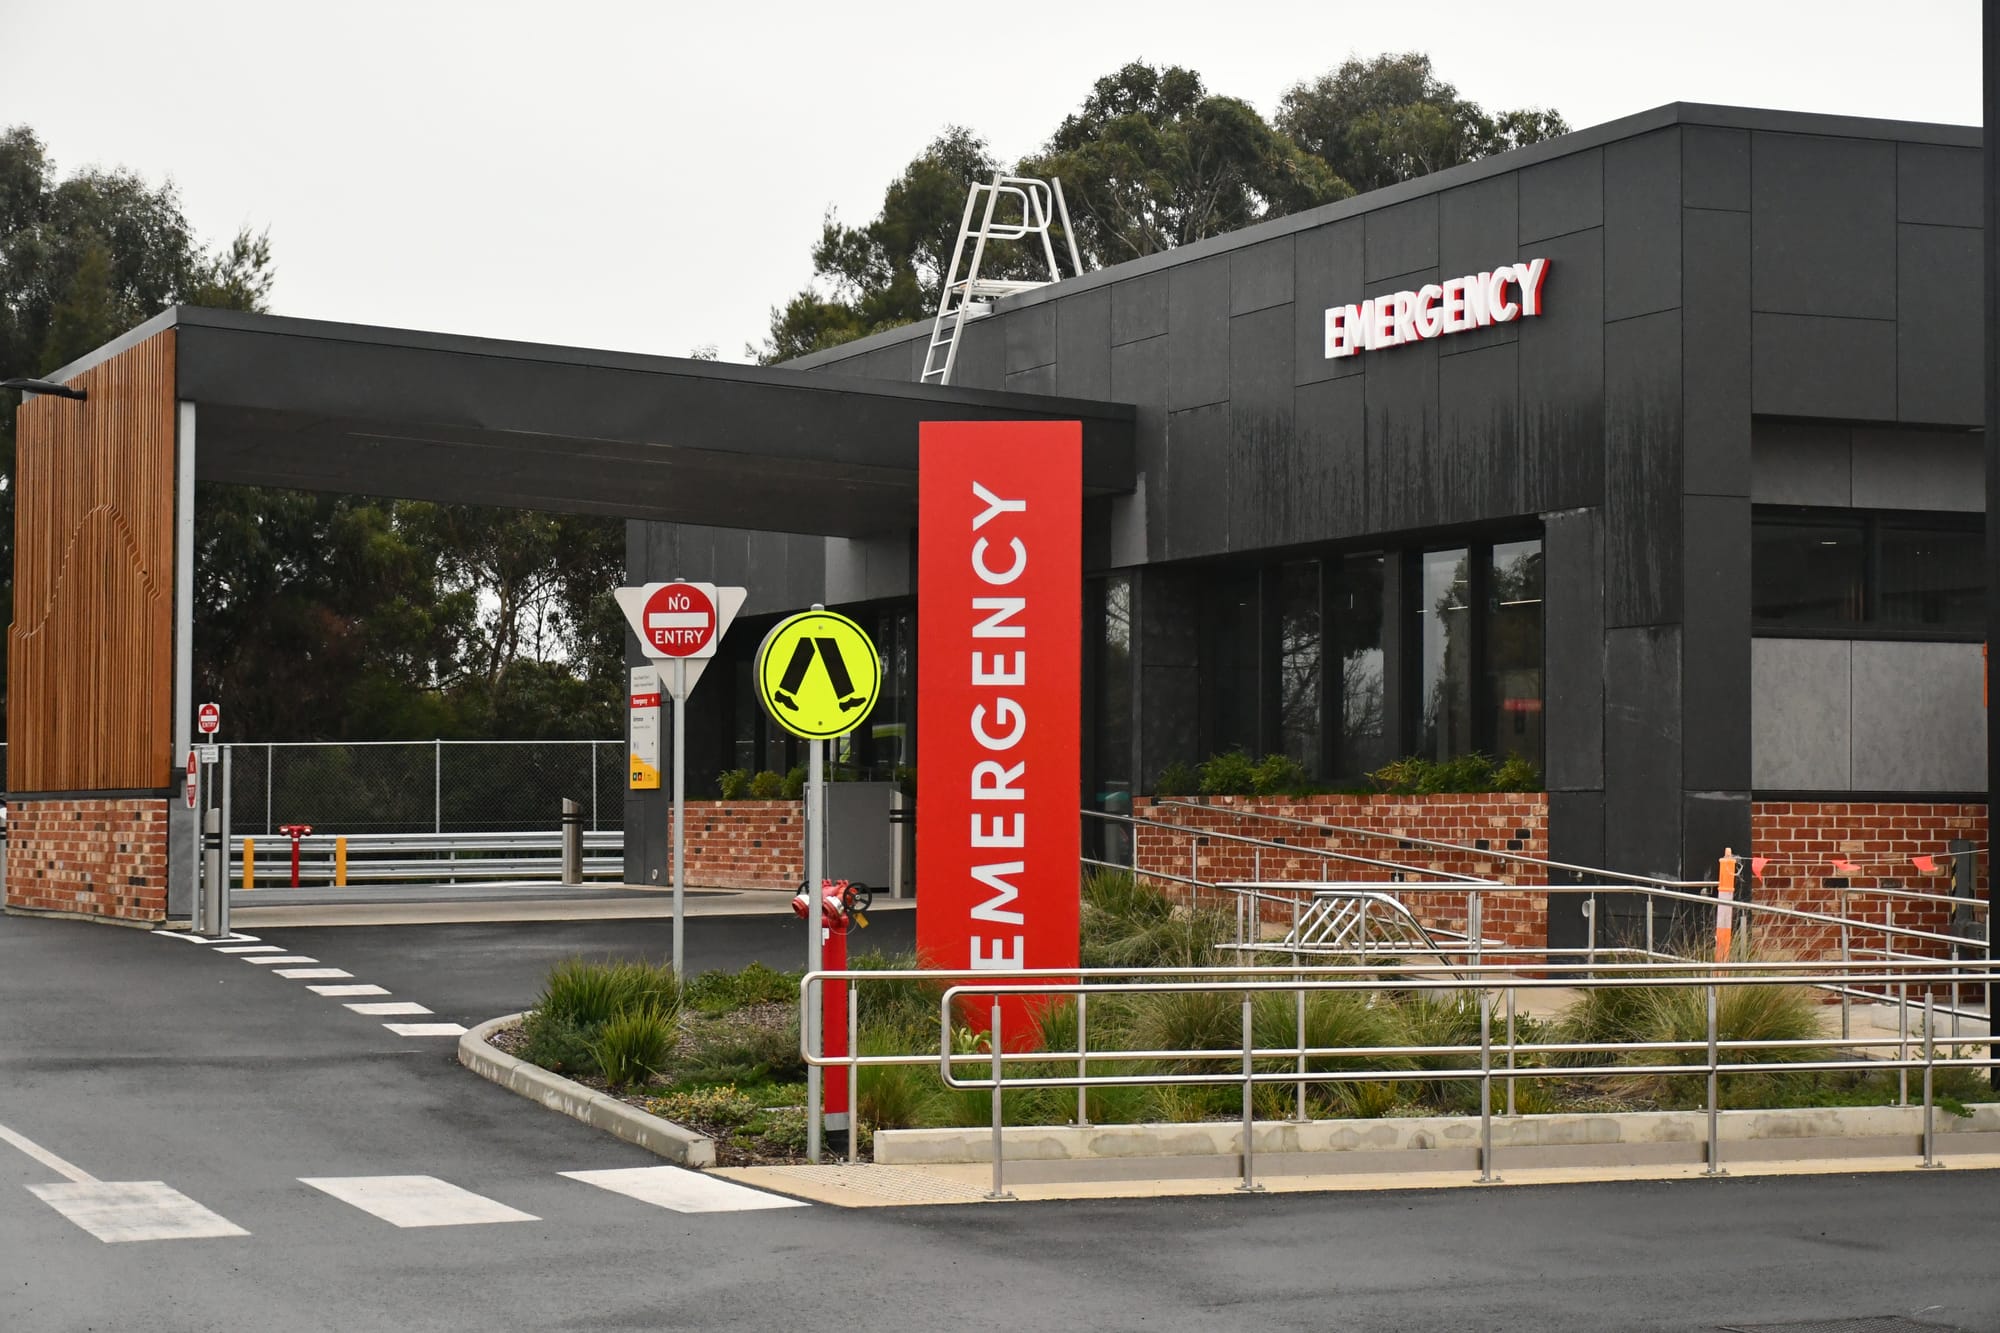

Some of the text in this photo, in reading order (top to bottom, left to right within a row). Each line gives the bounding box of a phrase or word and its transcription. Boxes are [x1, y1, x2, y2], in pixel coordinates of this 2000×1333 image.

[1325, 258, 1550, 359] EMERGENCY
[668, 596, 690, 610] NO
[655, 630, 704, 644] ENTRY
[970, 480, 1027, 970] EMERGENCY
